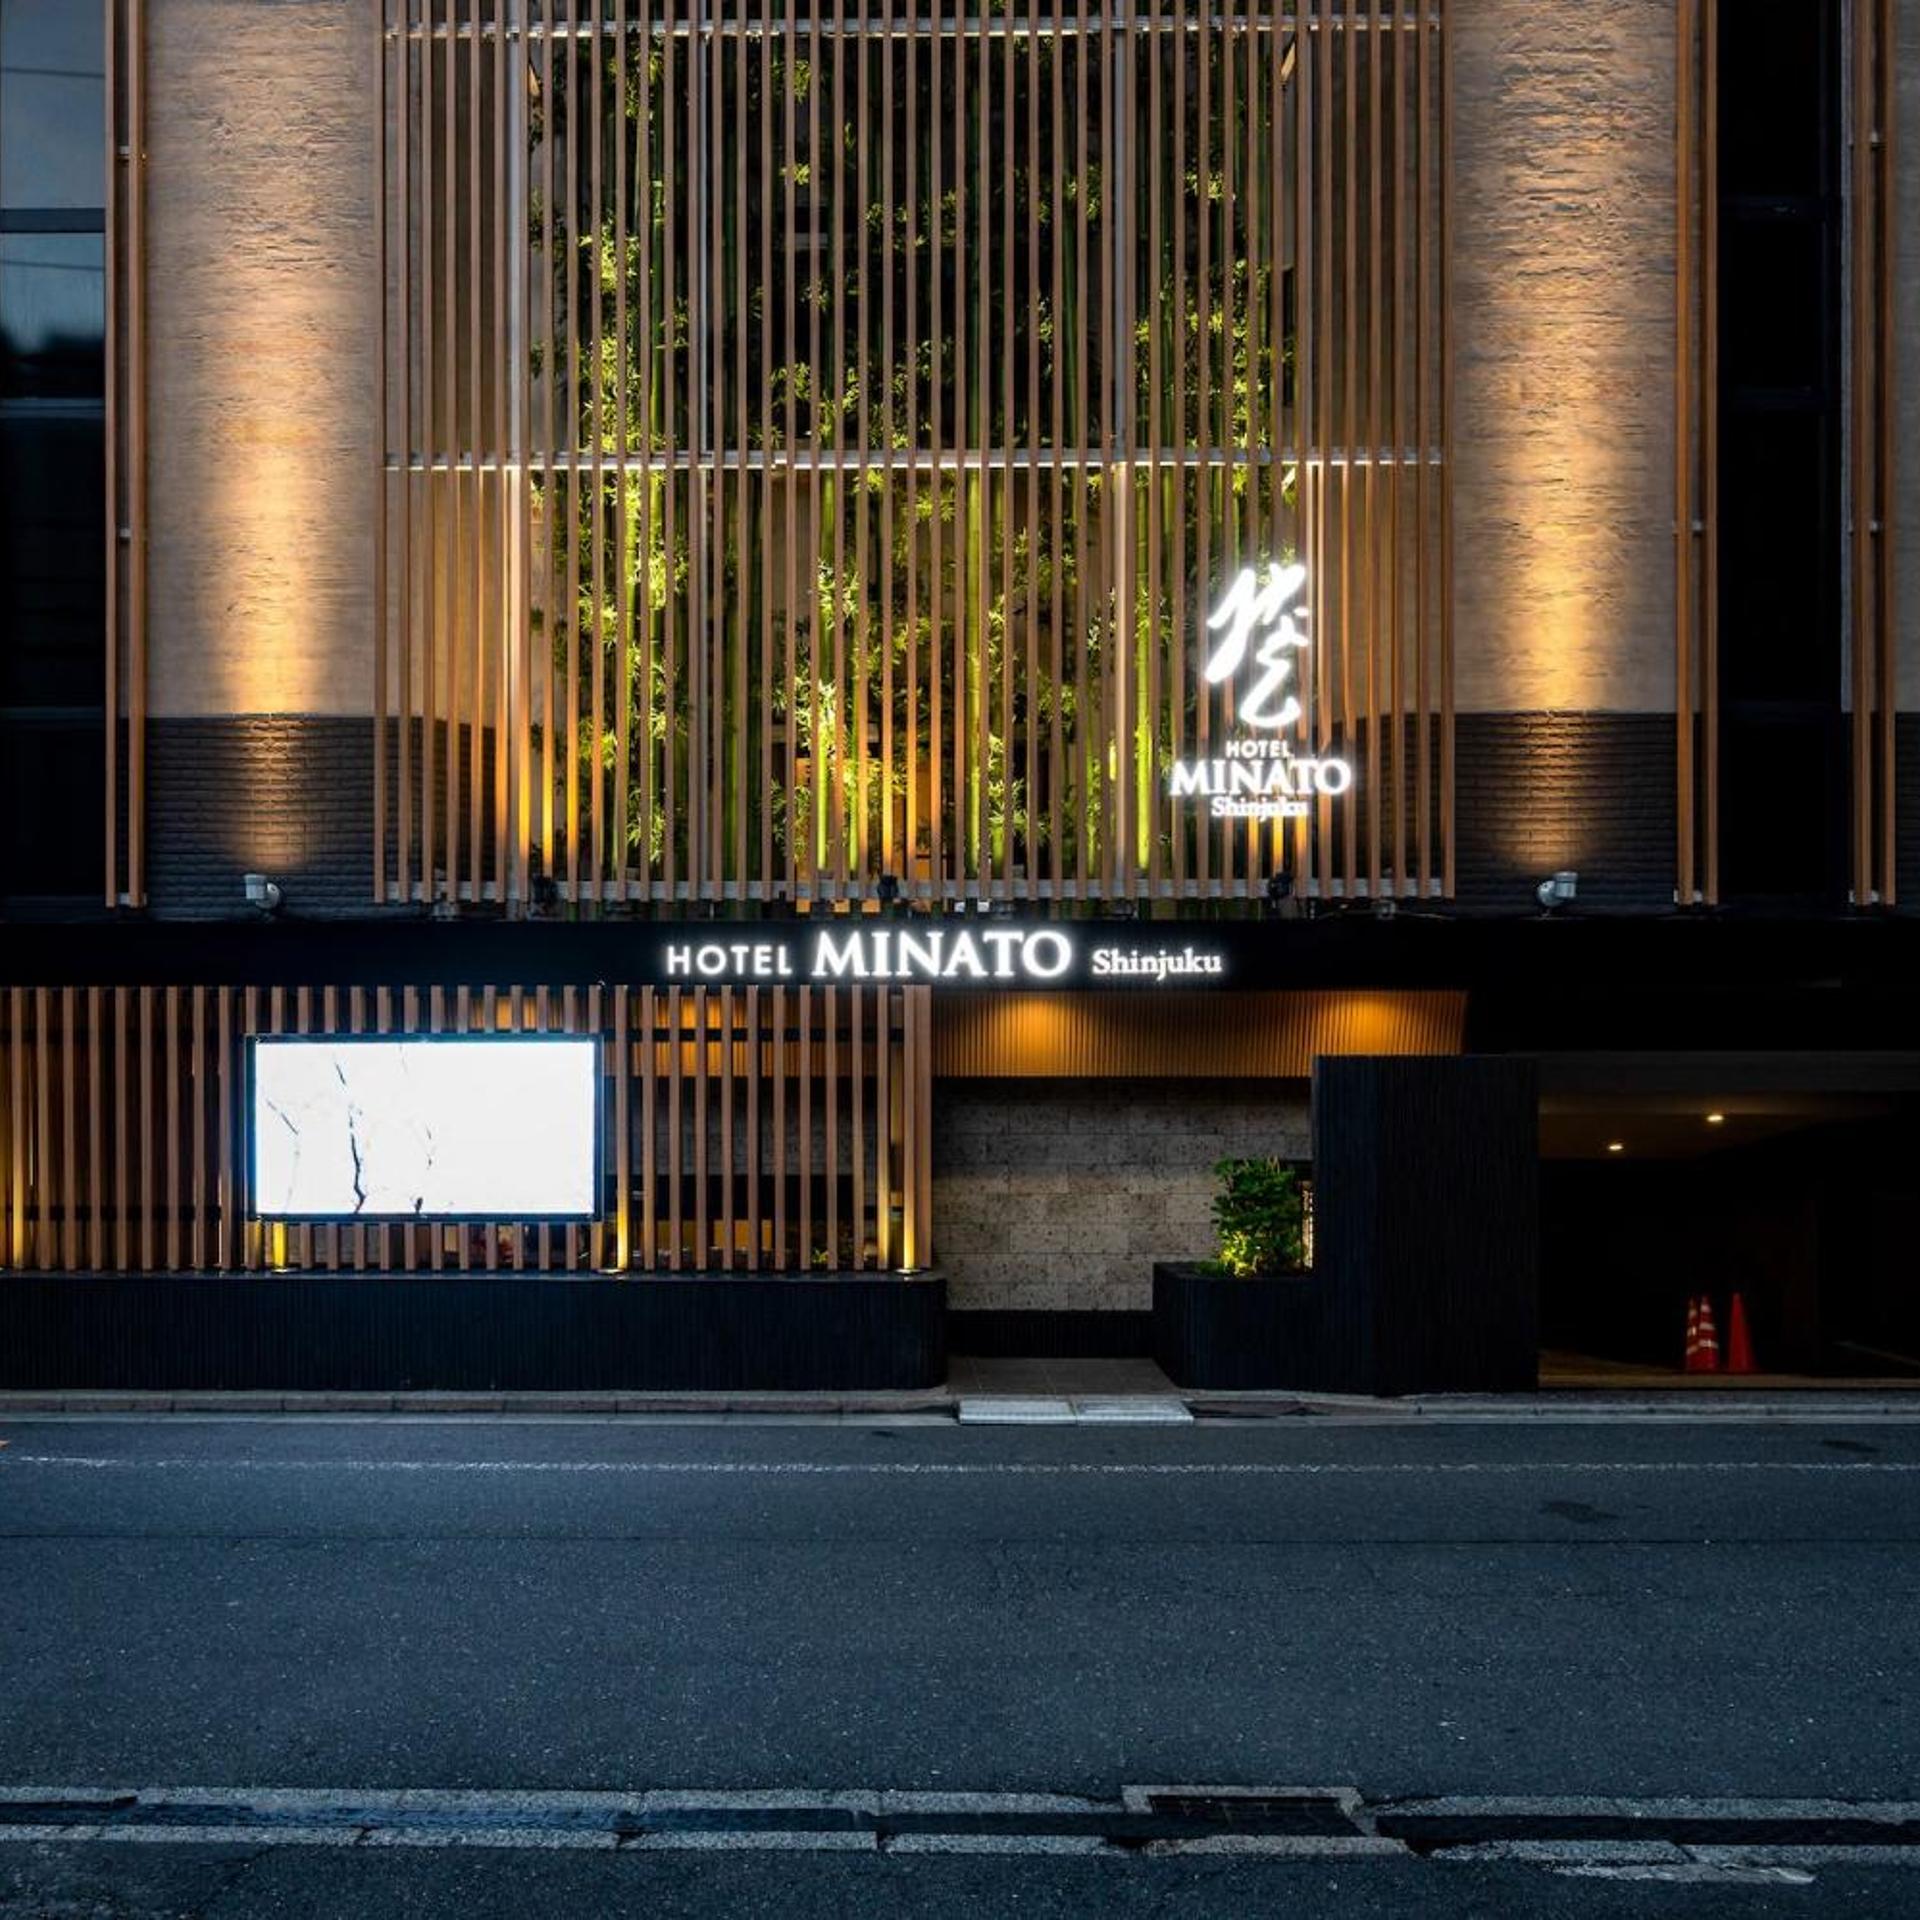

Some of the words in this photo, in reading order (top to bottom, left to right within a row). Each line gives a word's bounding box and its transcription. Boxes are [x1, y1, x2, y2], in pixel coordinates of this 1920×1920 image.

[1225, 740, 1291, 758] HOTEL
[1169, 758, 1352, 796] MINATO
[1211, 796, 1309, 821] Shinjuku
[666, 945, 792, 975] HOTEL
[811, 931, 1072, 977] MINATO
[1091, 947, 1222, 981] Shinjuku
